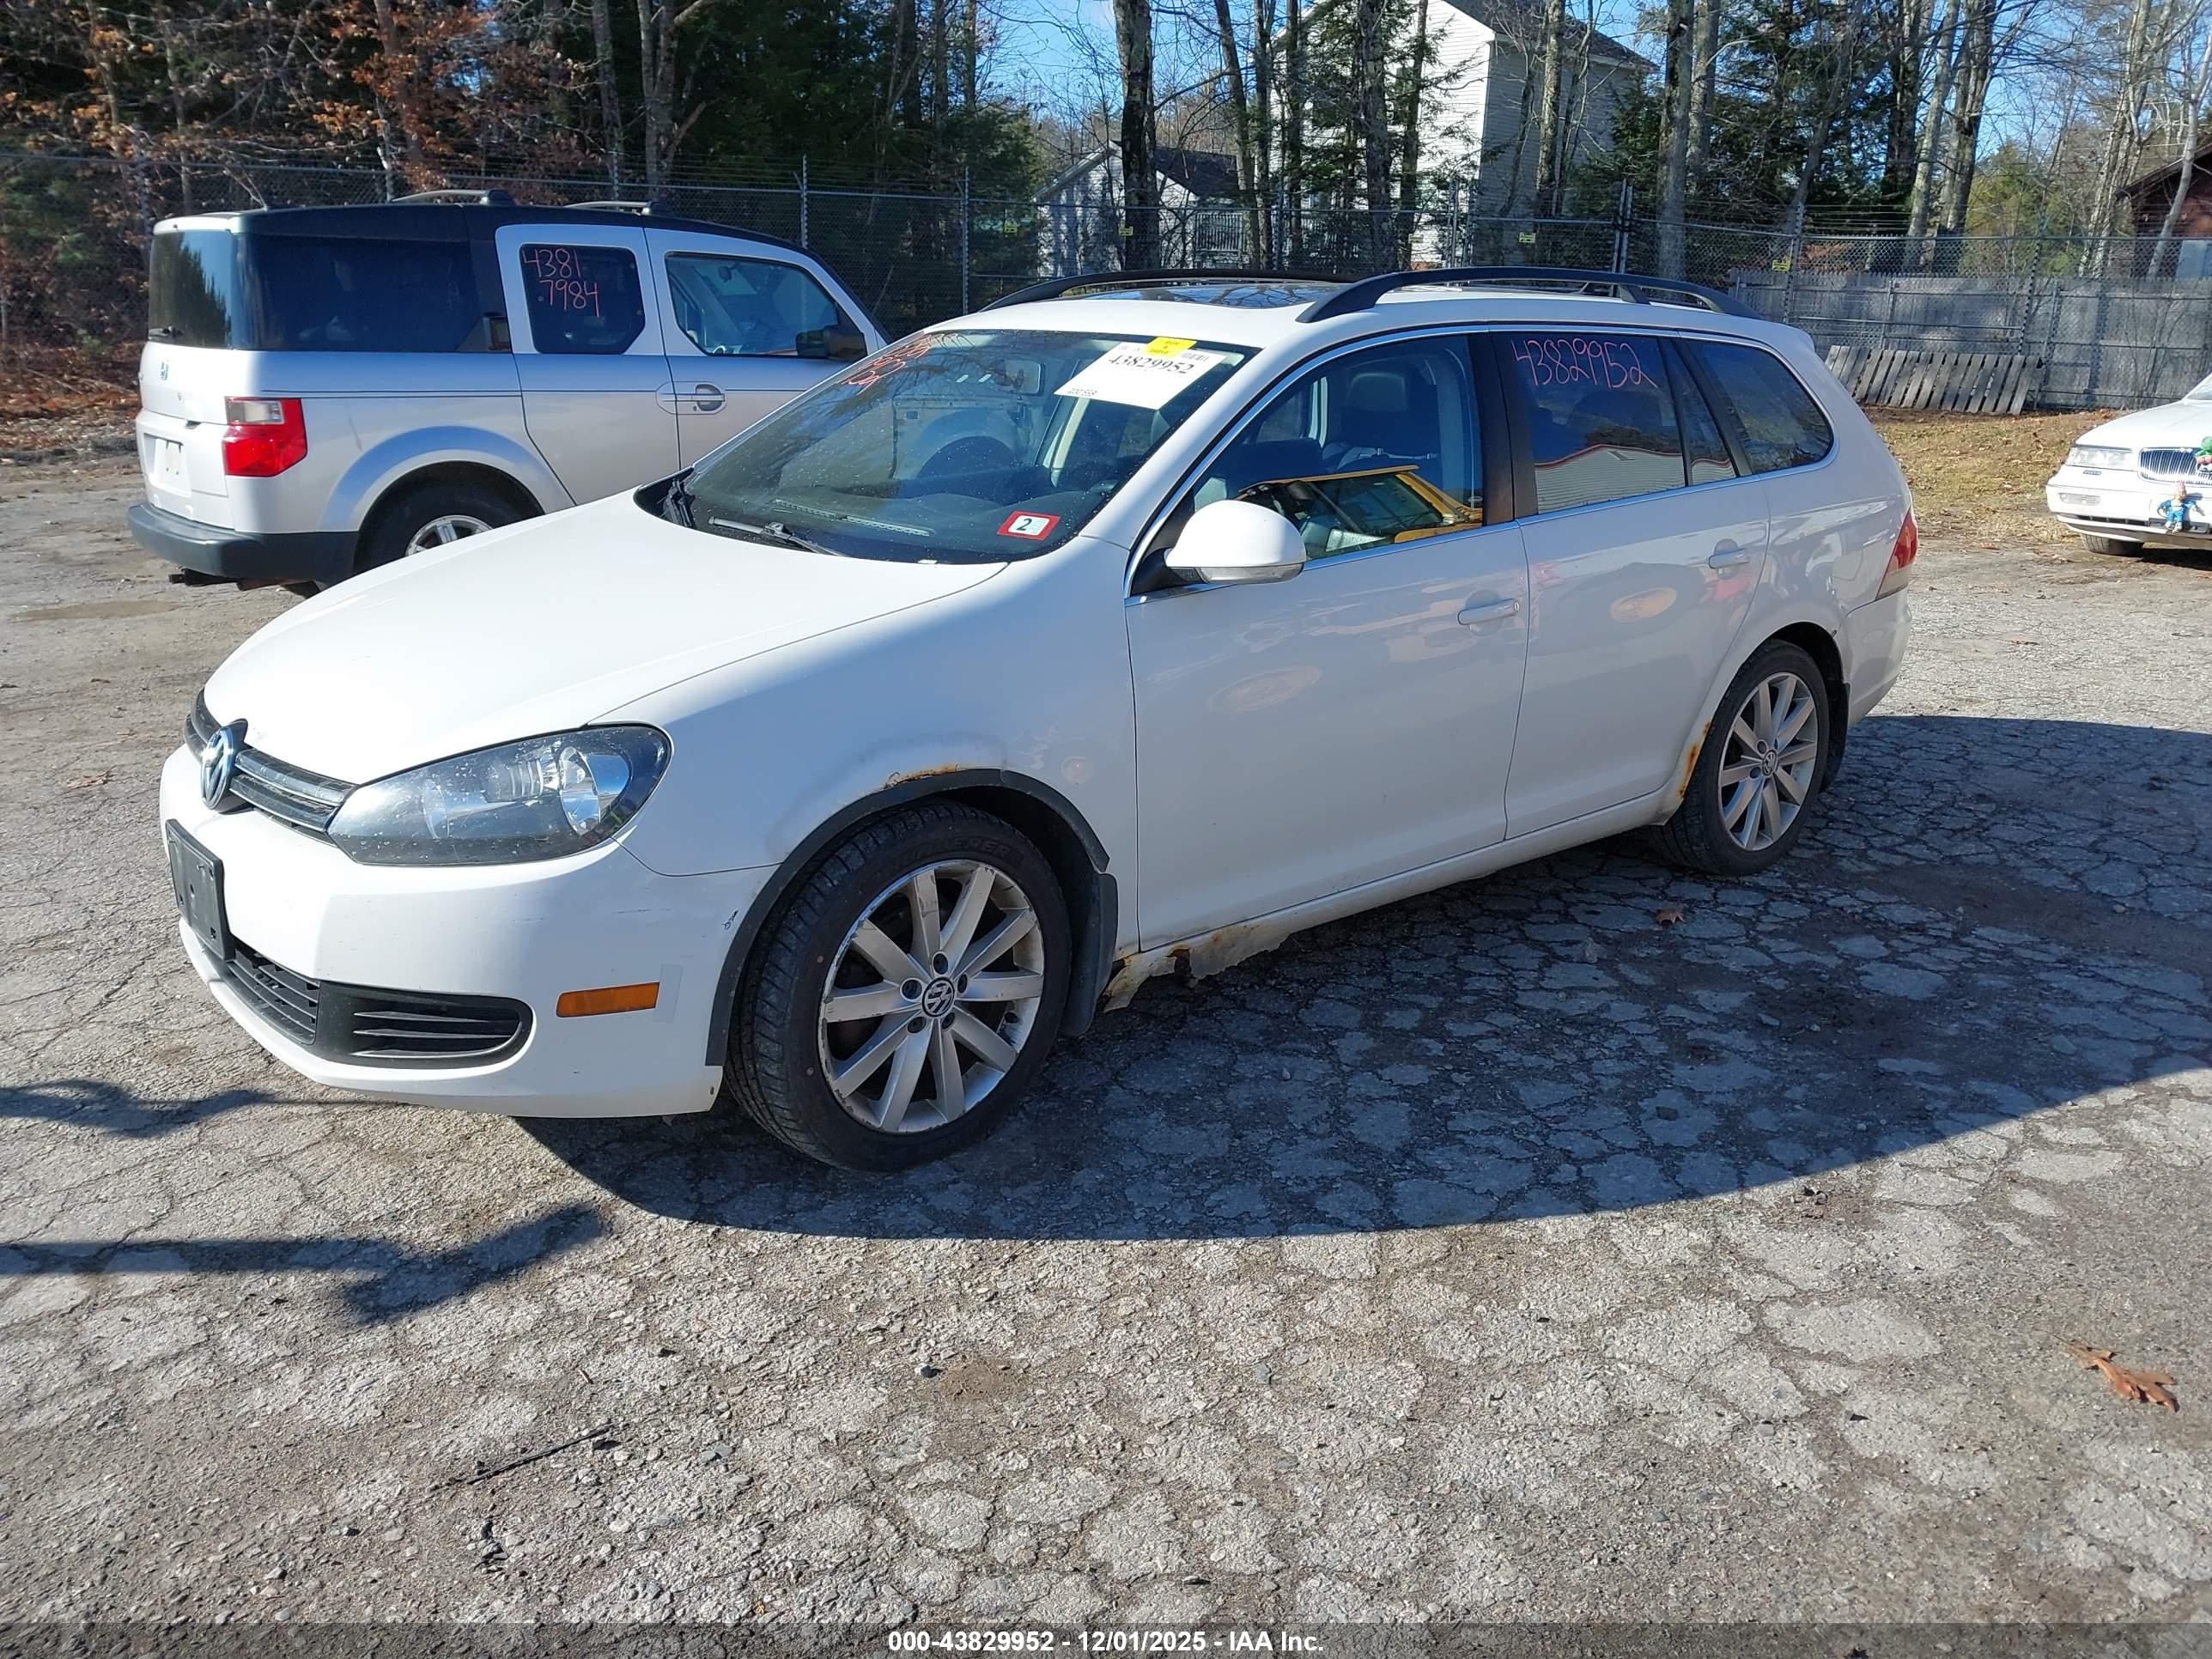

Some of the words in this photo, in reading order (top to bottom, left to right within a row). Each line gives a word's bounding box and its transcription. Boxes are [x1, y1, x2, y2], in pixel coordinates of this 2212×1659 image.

[522, 248, 580, 278] 4381
[539, 279, 599, 317] 7984
[1109, 355, 1194, 374] 43829952
[1511, 337, 1659, 389] 43829952
[1017, 518, 1032, 531] 2
